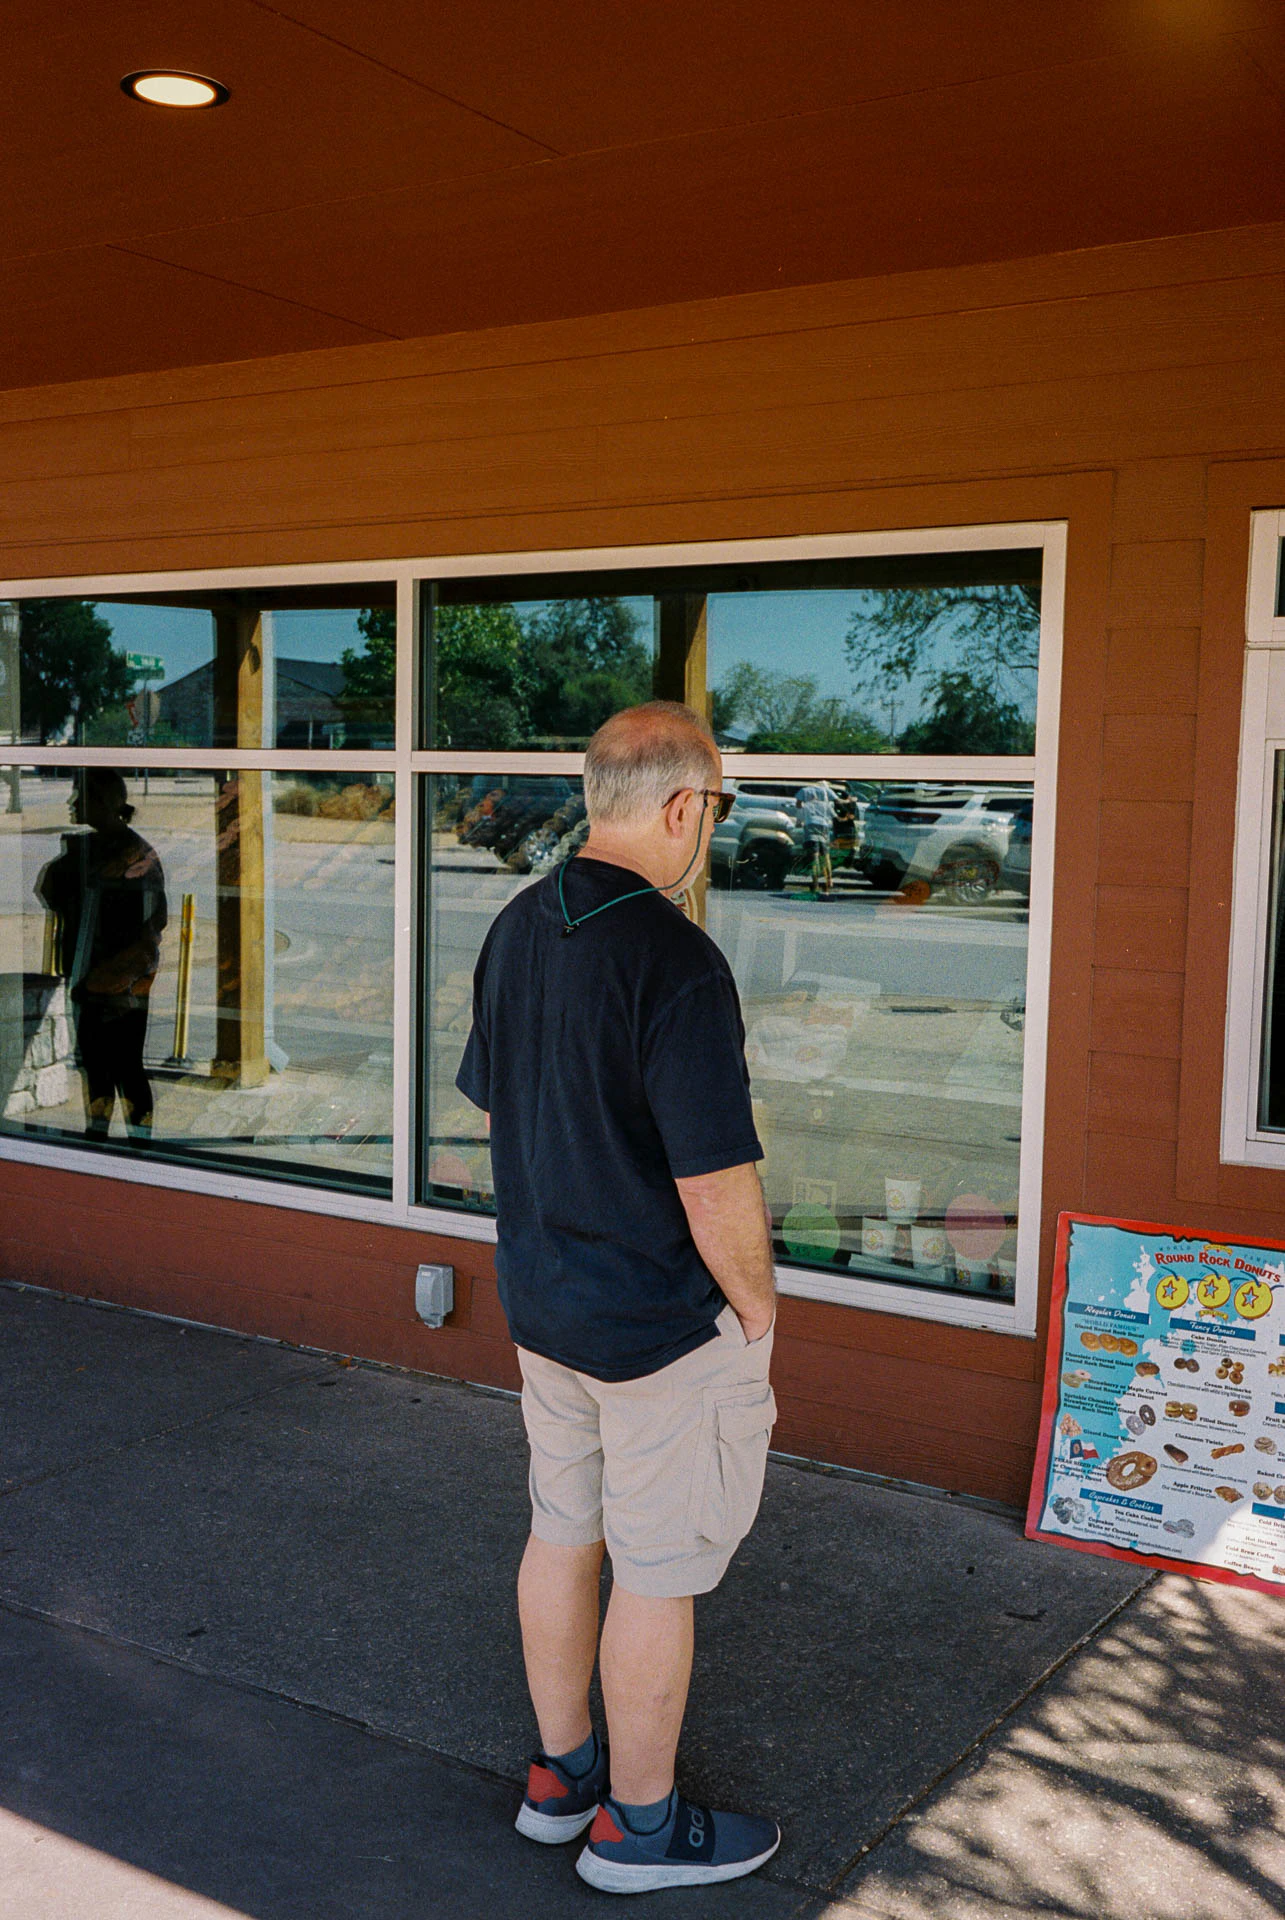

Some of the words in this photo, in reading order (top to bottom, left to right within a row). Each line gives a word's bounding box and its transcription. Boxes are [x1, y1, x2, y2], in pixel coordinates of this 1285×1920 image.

[1155, 1253, 1195, 1264] ROUND
[1199, 1252, 1230, 1268] ROCK
[1085, 1306, 1112, 1316] Regular
[1114, 1311, 1136, 1320] Donuts
[1190, 1321, 1210, 1332] Fancy
[1212, 1326, 1235, 1335] Donuts
[1065, 1352, 1091, 1360] Chocolate
[1092, 1356, 1113, 1364] Covered
[1088, 1379, 1118, 1388] Strawberry
[1128, 1385, 1144, 1393] Maple
[1088, 1397, 1114, 1406] Chocolate
[1175, 1433, 1203, 1442] Cinnamon
[1060, 1464, 1085, 1473] Chocolate
[1089, 1492, 1119, 1504] Cupcakes
[1129, 1500, 1154, 1511] Cookies
[1089, 1517, 1114, 1526] Cupcakes
[1112, 1528, 1139, 1537] Chocolate
